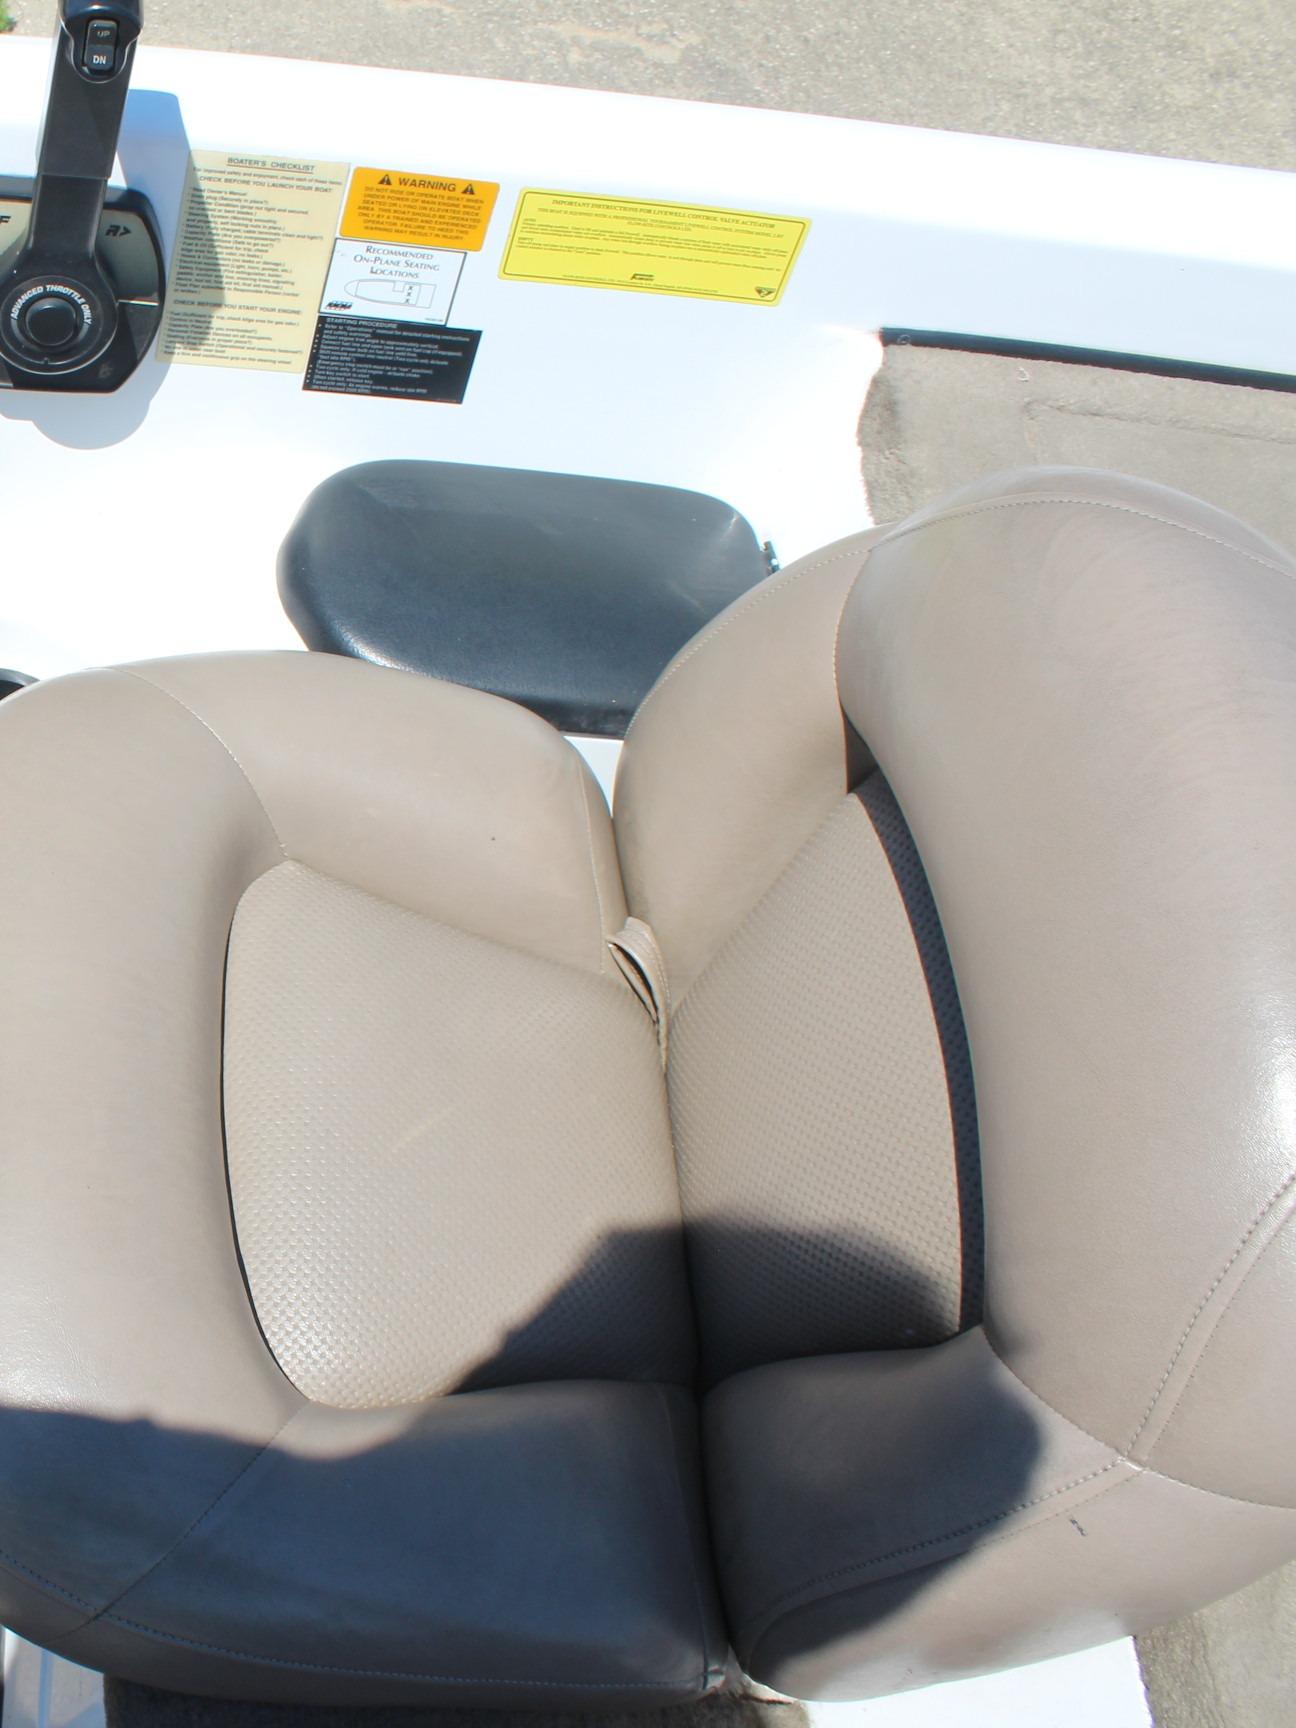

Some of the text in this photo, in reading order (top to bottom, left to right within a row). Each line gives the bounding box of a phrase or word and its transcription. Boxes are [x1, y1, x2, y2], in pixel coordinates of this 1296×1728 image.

[97, 30, 111, 38] UP
[92, 55, 107, 65] DN
[228, 157, 315, 171] BOATER'S CHECKLIST
[200, 176, 223, 184] CHECK
[224, 178, 250, 186] BEFORE
[267, 182, 294, 190] LAUNCH
[398, 177, 456, 192] WARNING
[417, 192, 446, 200] OPERATE
[552, 199, 590, 209] IMPORTANT
[591, 203, 638, 213] INSTRUCTIONS
[653, 209, 687, 218] LIVEWELL
[688, 212, 718, 222] CONTROL
[741, 220, 775, 229] ACTUATOR
[364, 225, 393, 233] WARNING
[365, 245, 434, 260] RECOMMENDED
[353, 254, 440, 272] ON-PLANE SEATING
[369, 266, 420, 279] LOCATIONS
[10, 284, 92, 325] ADVANCED THROTTLE ONLY
[326, 317, 398, 329] STARTING PROCEDURE
